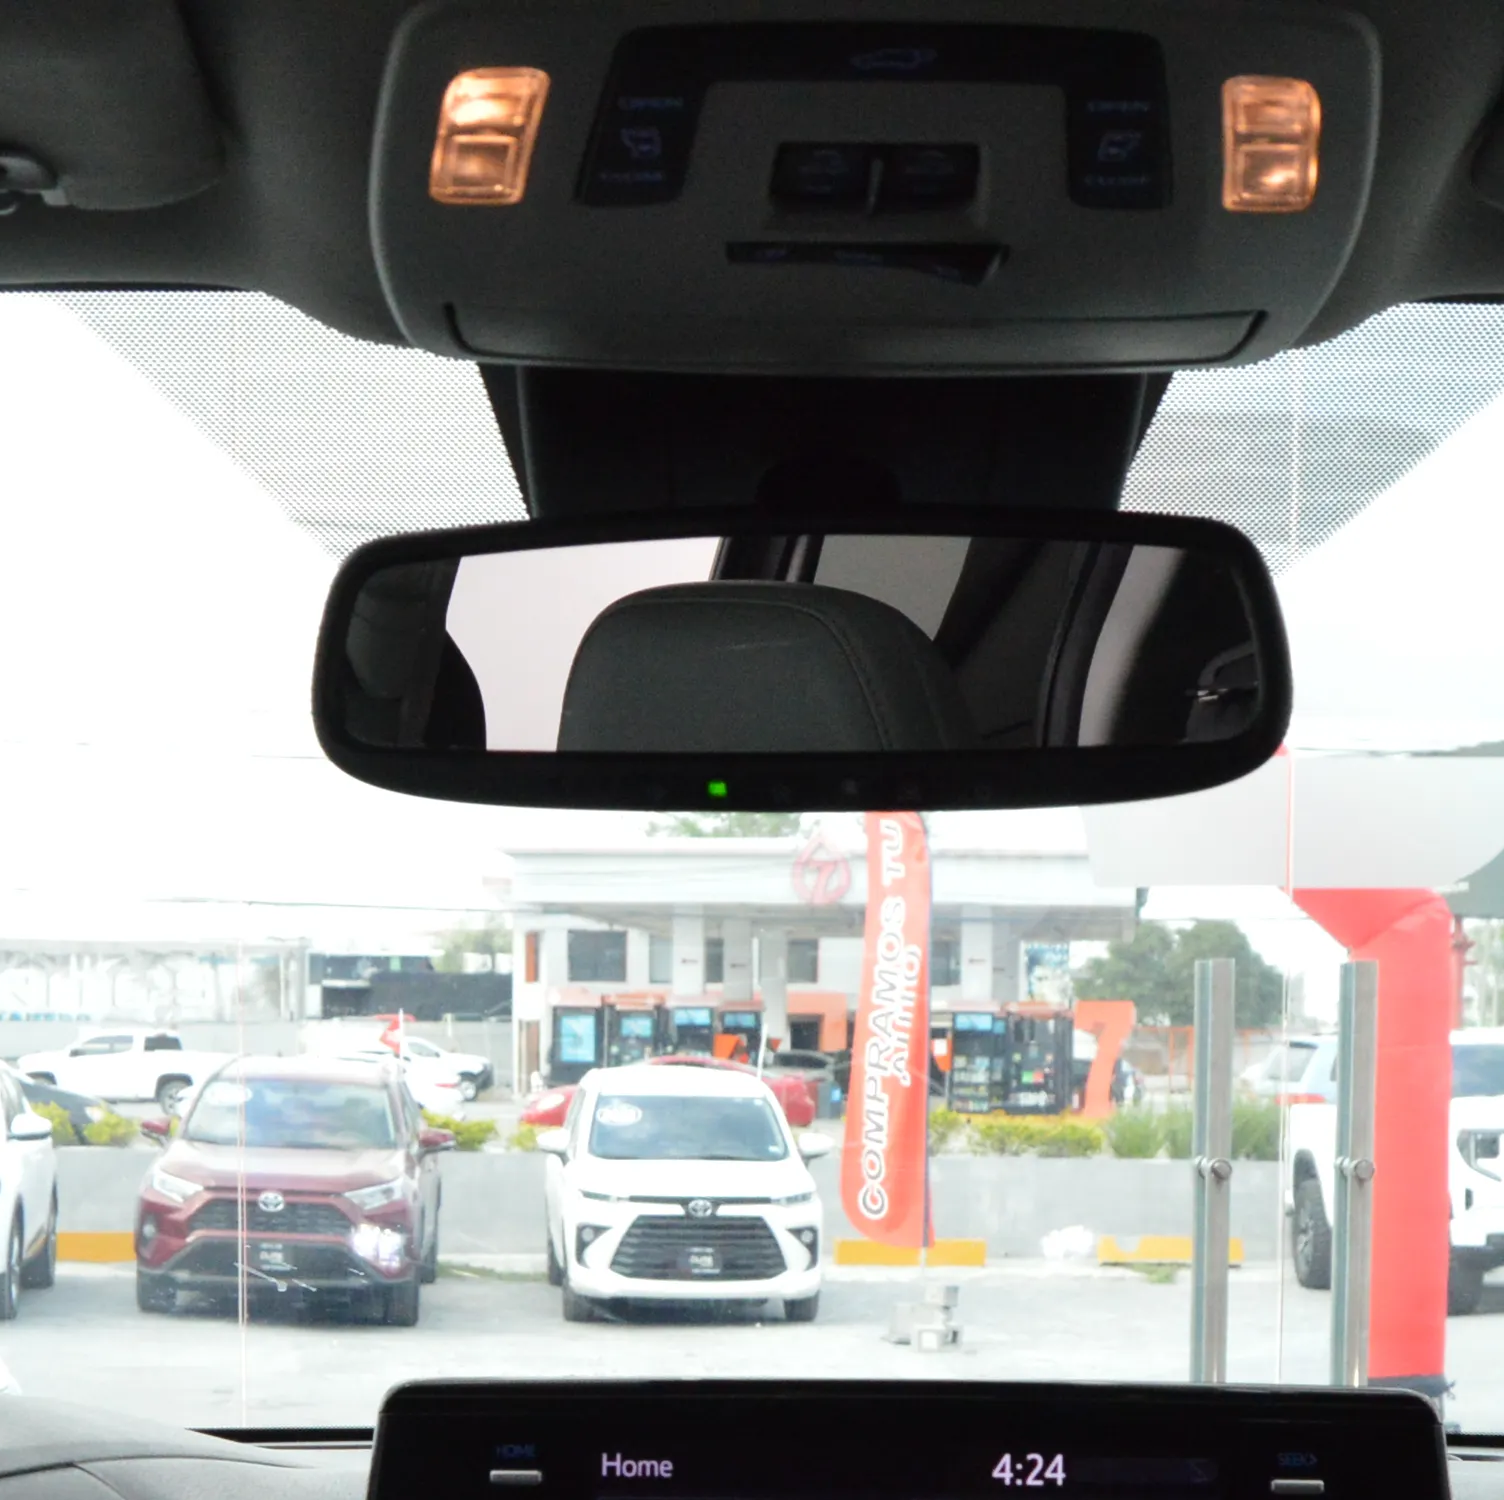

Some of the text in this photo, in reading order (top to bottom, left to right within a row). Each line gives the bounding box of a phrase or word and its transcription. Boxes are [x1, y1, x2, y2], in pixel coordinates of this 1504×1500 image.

[858, 818, 905, 1220] COMPRAMOS TU
[1074, 1000, 1136, 1118] 7
[496, 1444, 536, 1458] HOME
[601, 1452, 674, 1478] Home
[992, 1453, 1067, 1487] 4:24
